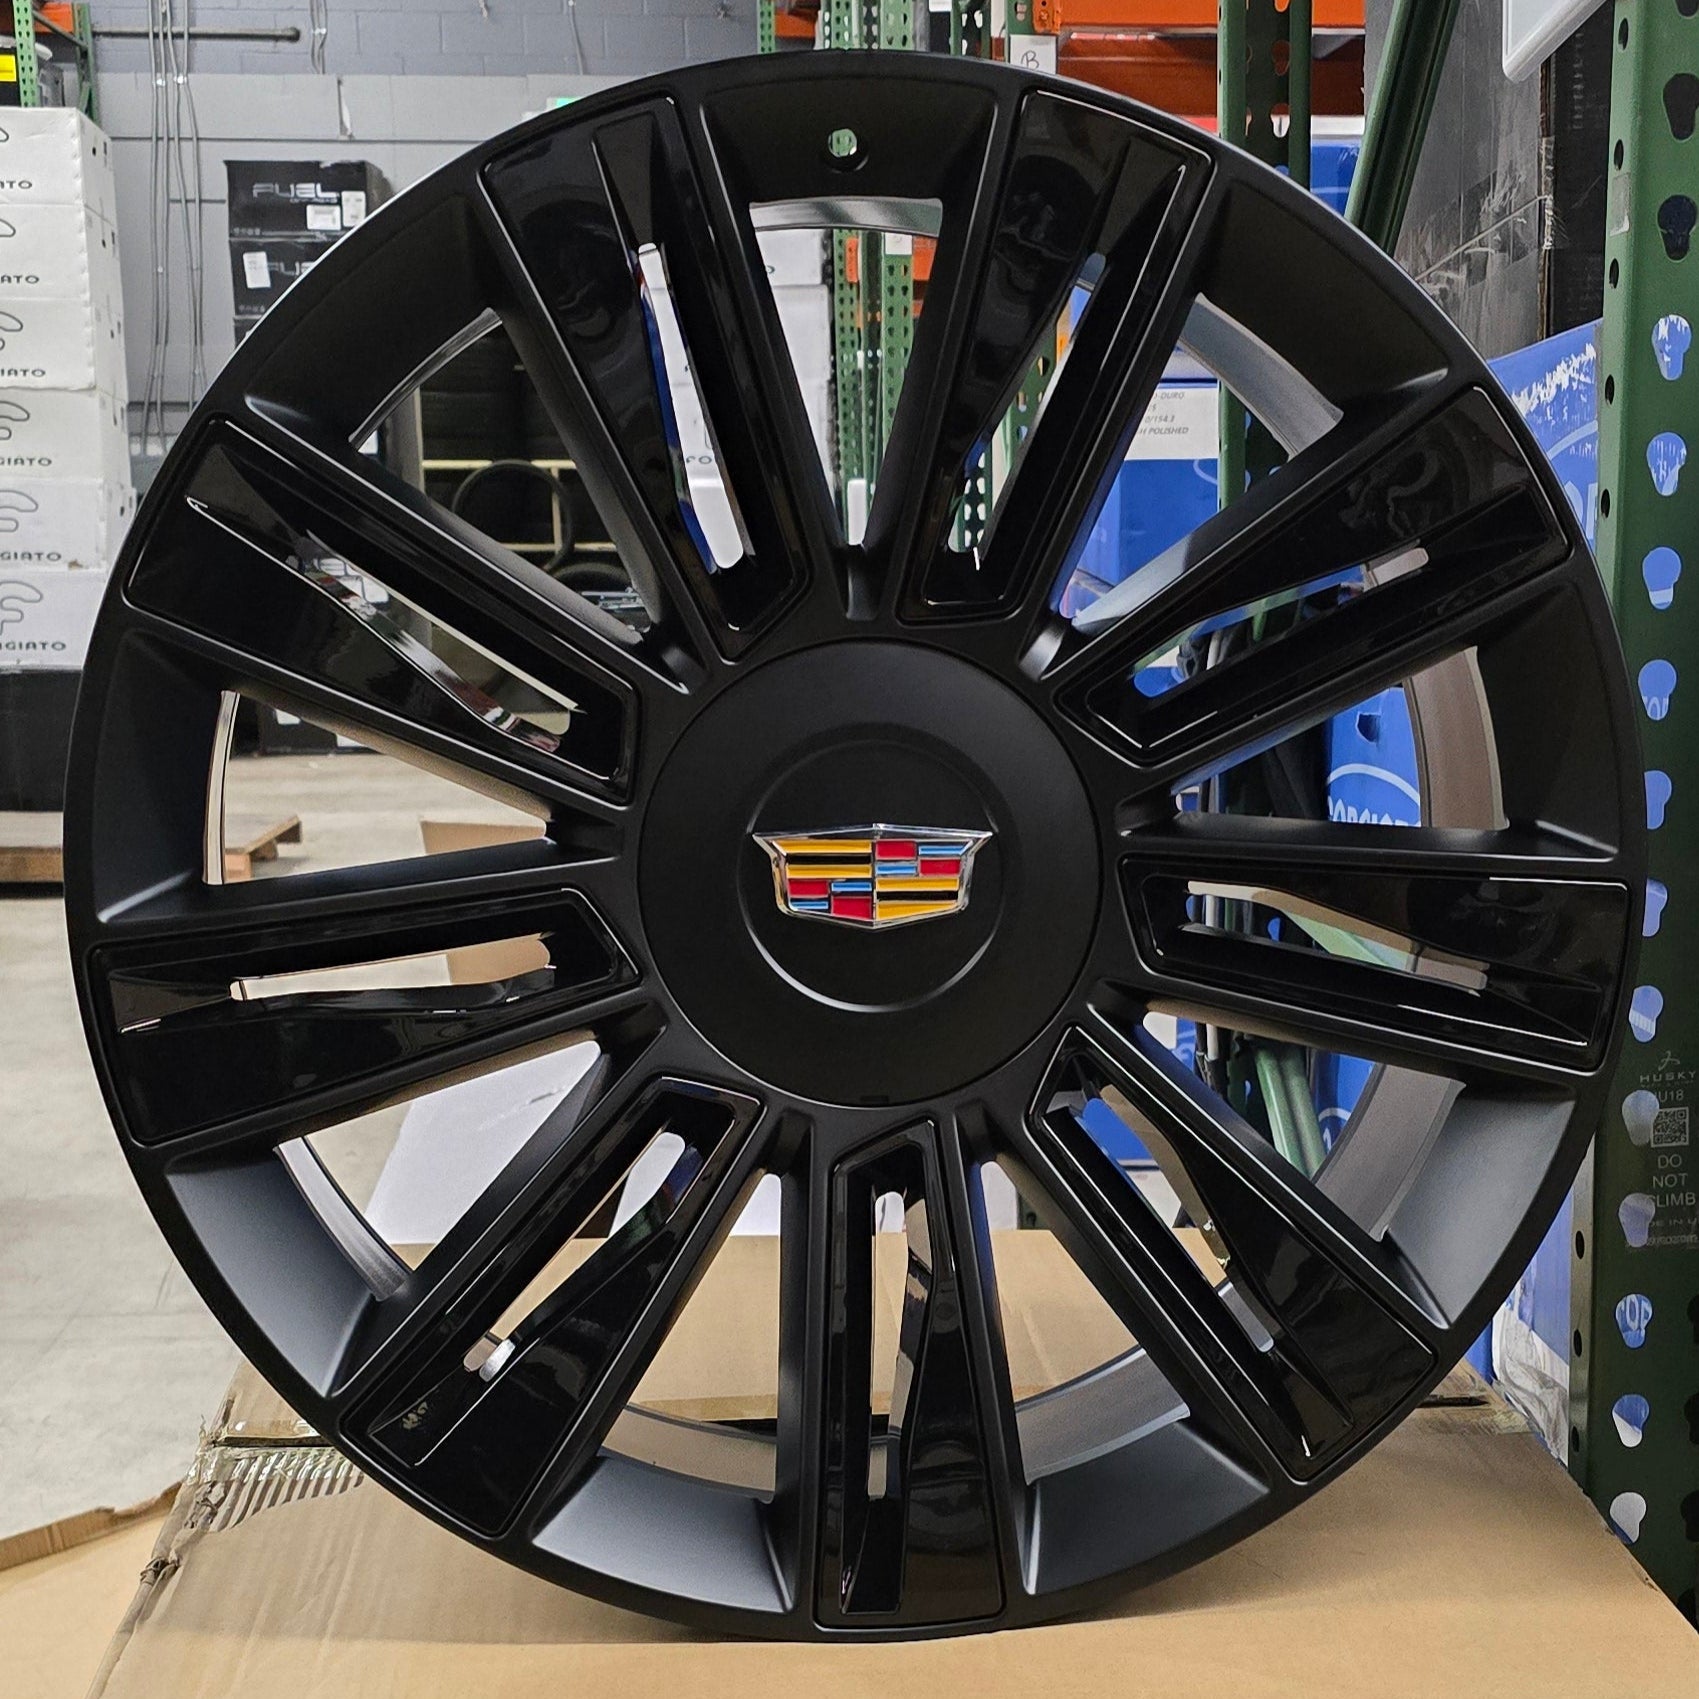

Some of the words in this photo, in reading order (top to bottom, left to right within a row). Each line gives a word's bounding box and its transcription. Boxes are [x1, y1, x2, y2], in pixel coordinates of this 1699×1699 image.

[253, 183, 340, 198] FUEL
[0, 551, 62, 561] GIATO
[0, 641, 67, 651] GIATO
[1640, 1070, 1696, 1082] HUSKY
[1657, 1154, 1682, 1169] DO
[1652, 1172, 1688, 1189] NOT
[1645, 1191, 1697, 1208] LIMB
